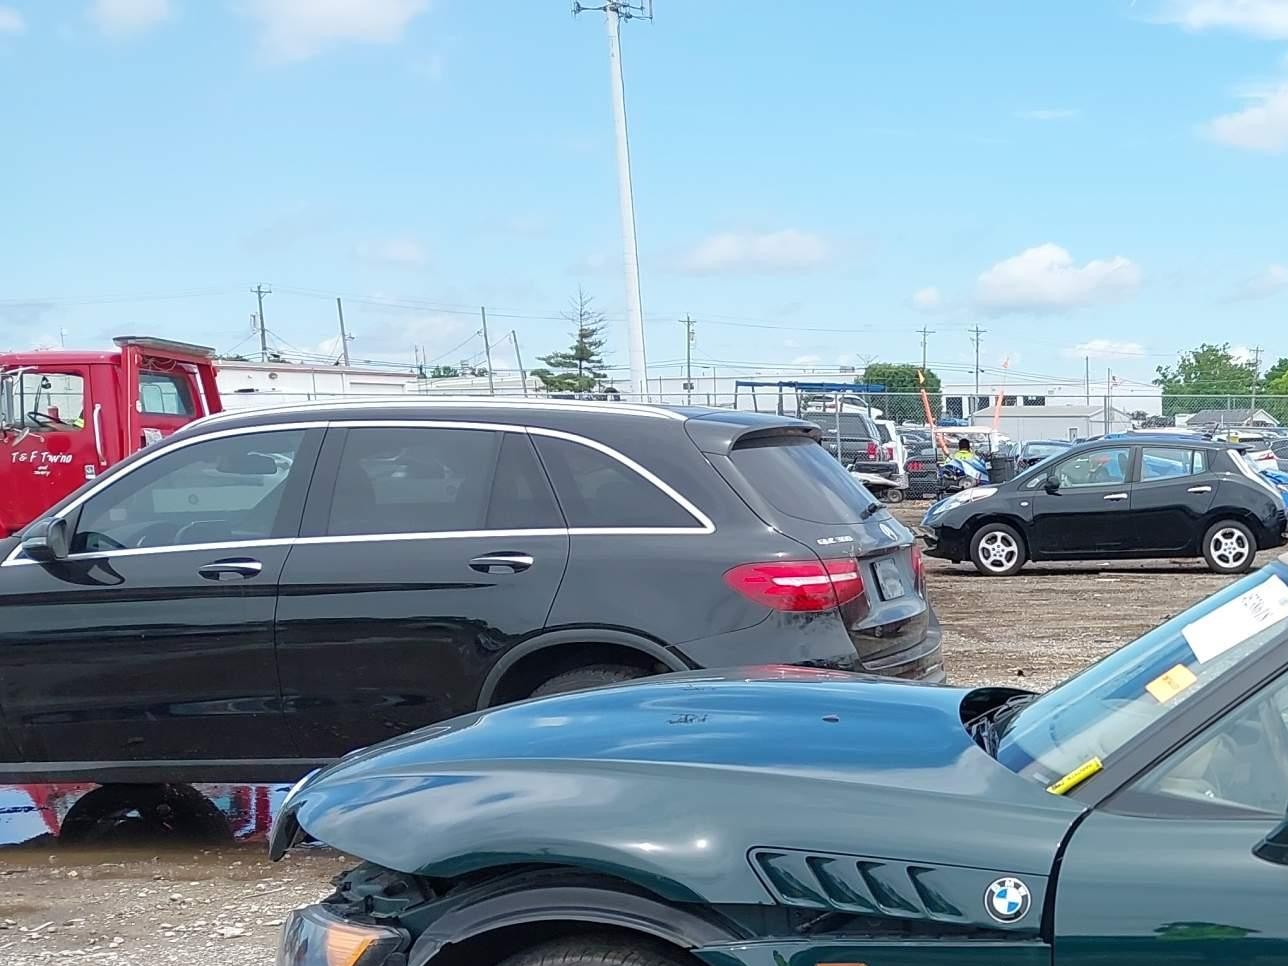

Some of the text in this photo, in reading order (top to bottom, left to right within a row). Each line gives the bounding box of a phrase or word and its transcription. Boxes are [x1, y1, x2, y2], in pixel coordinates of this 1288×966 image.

[11, 452, 19, 463] T
[19, 453, 27, 462] &
[29, 450, 38, 463] F
